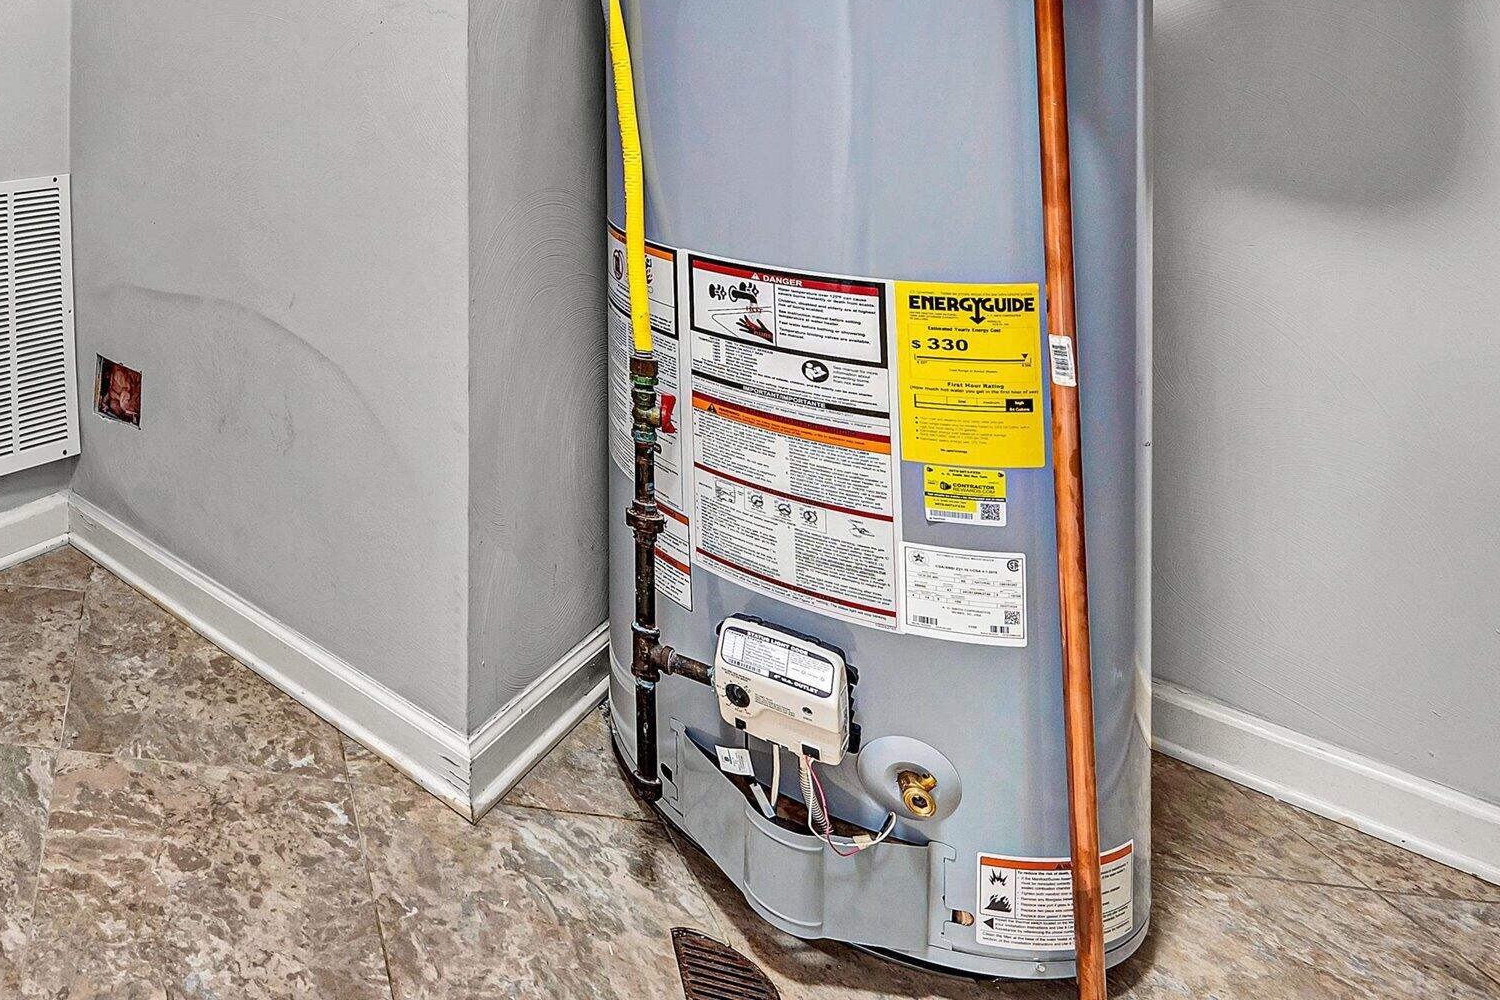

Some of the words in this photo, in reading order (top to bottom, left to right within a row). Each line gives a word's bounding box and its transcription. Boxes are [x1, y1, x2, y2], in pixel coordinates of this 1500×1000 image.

[763, 275, 802, 286] DANGER
[909, 295, 1034, 313] ENERGYGUIDE
[911, 339, 921, 349] $
[927, 338, 968, 351] 330
[747, 631, 770, 642] STATUS
[771, 639, 790, 649] LIGHT
[790, 646, 808, 656] CODE
[794, 681, 818, 693] OUTLET
